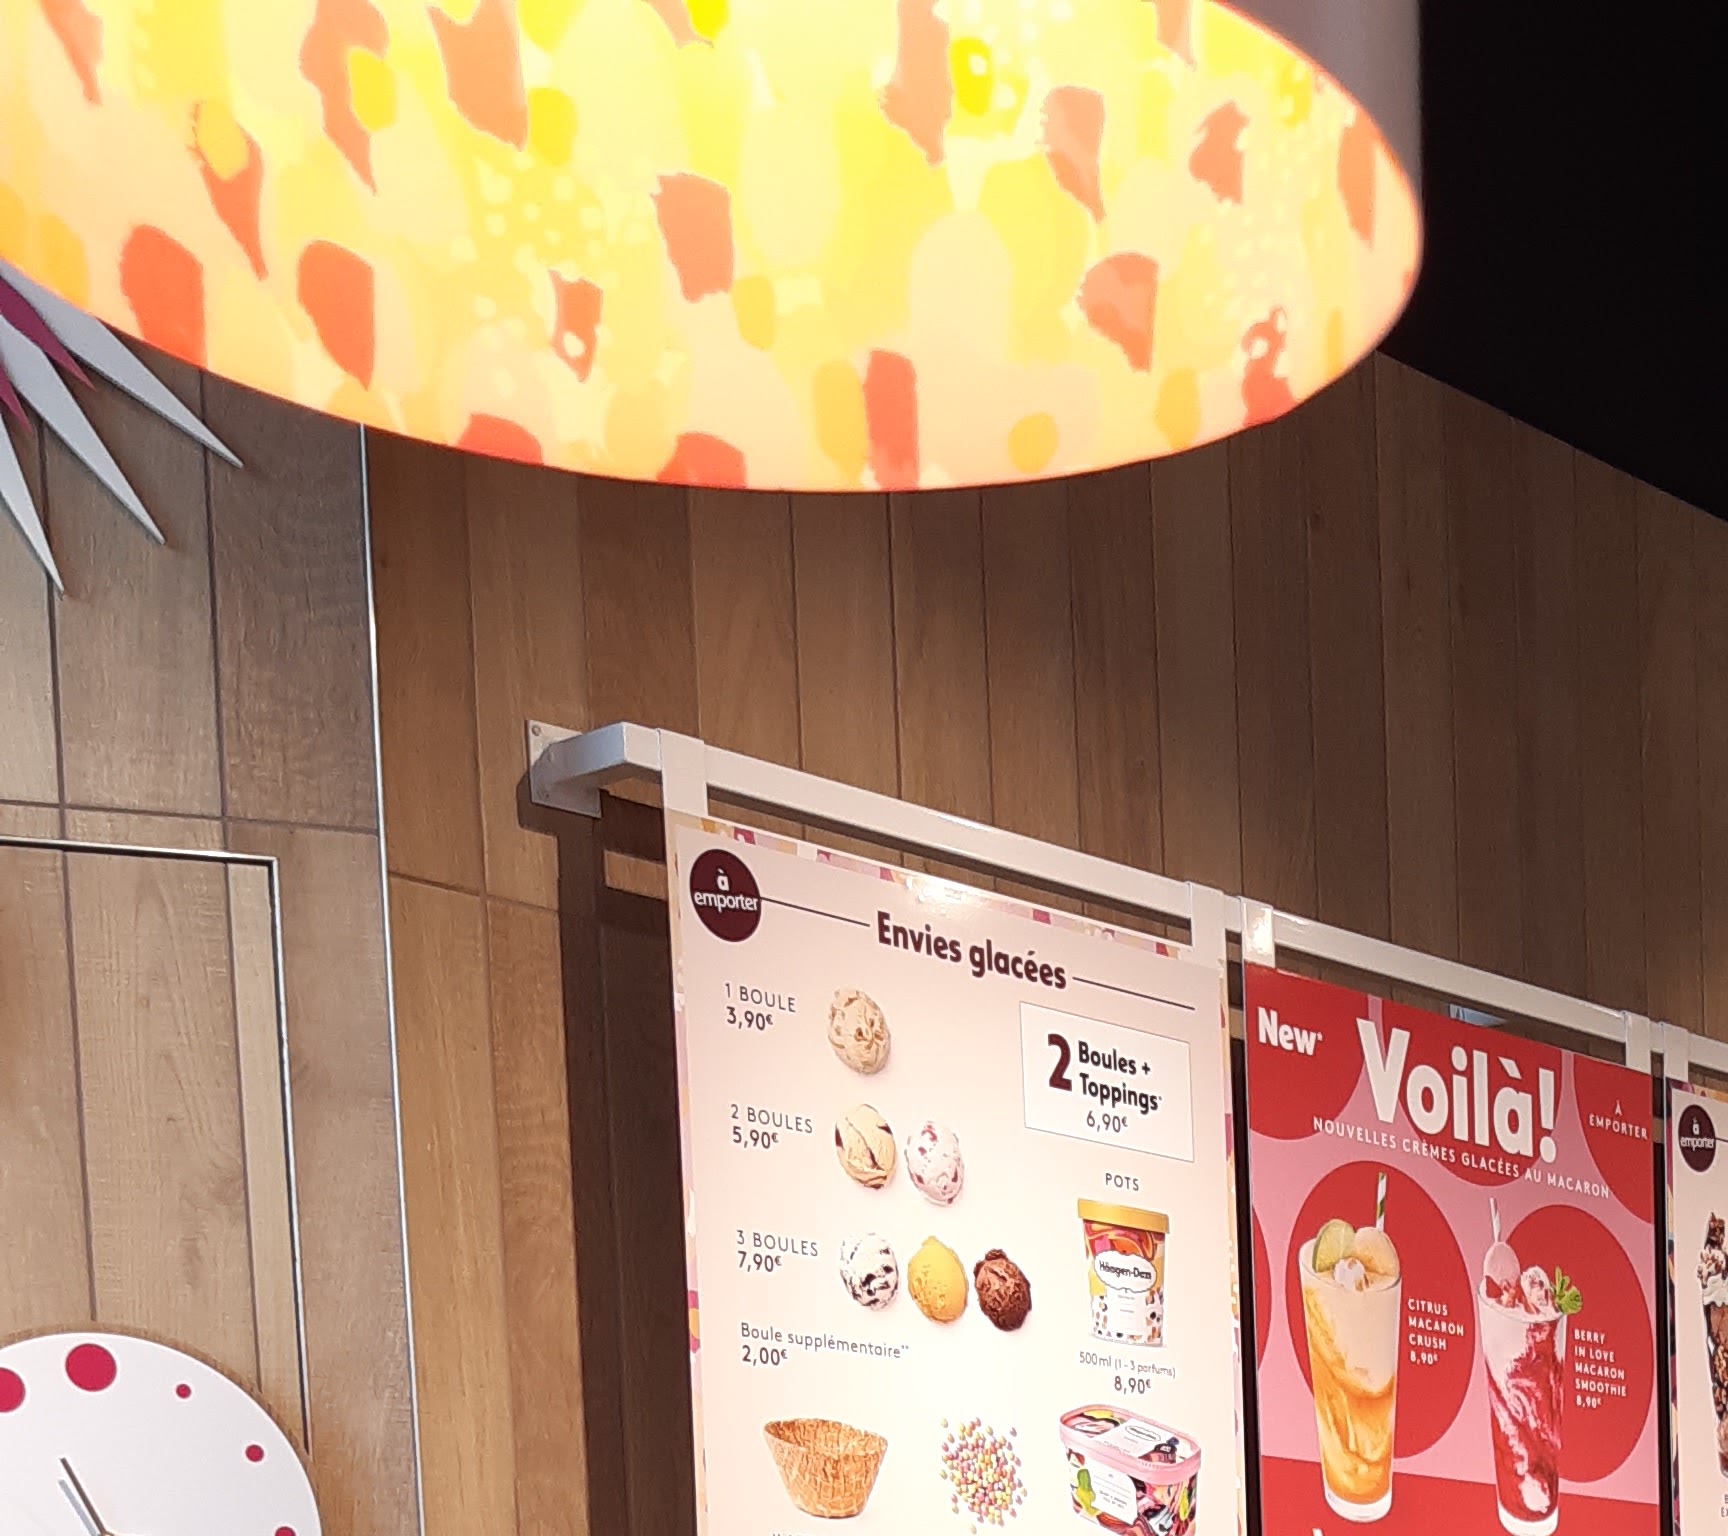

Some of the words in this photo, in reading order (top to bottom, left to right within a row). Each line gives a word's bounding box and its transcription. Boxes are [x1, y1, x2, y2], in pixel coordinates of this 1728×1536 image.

[717, 870, 729, 891] à
[694, 890, 758, 912] emporter
[877, 911, 962, 963] Envies
[969, 937, 1067, 990] glacées
[725, 984, 731, 999] 1
[738, 986, 796, 1014] BOULE
[726, 1006, 774, 1031] 3,90€
[1047, 1034, 1072, 1092] 2
[1078, 1041, 1136, 1075] Boules
[1141, 1061, 1151, 1075] +
[1356, 1018, 1558, 1163] Voilà!
[731, 1105, 739, 1120] 2
[747, 1106, 813, 1135] BOULES
[1086, 1110, 1128, 1134] 6,90€
[1589, 1114, 1648, 1140] EMPORTER
[1692, 1117, 1700, 1134] à
[732, 1126, 779, 1151] 5,90€
[1680, 1135, 1715, 1151] emporter
[1313, 1116, 1397, 1149] NOUVELLES
[1403, 1134, 1456, 1163] CRÈMES
[1461, 1152, 1520, 1178] GLACÉES
[1524, 1168, 1542, 1184] AU
[1547, 1171, 1610, 1200] MACARON
[1105, 1172, 1140, 1191] POTS
[736, 1230, 744, 1246] 3
[752, 1232, 819, 1258] BOULES
[737, 1250, 782, 1273] 7,90€
[1408, 1299, 1448, 1316] CITRUS
[741, 1323, 783, 1344] Boule
[1409, 1316, 1464, 1336] MACARON
[1574, 1329, 1606, 1344] BERRY
[1409, 1334, 1447, 1351] CRUSH
[742, 1345, 788, 1367] 2,00€
[1574, 1346, 1587, 1359] IN
[1590, 1348, 1615, 1363] LOVE
[1130, 1361, 1135, 1371] 3
[1575, 1362, 1625, 1380] MACARON
[1114, 1376, 1151, 1394] 8,90€
[1575, 1379, 1627, 1397] SMOOTHIE
